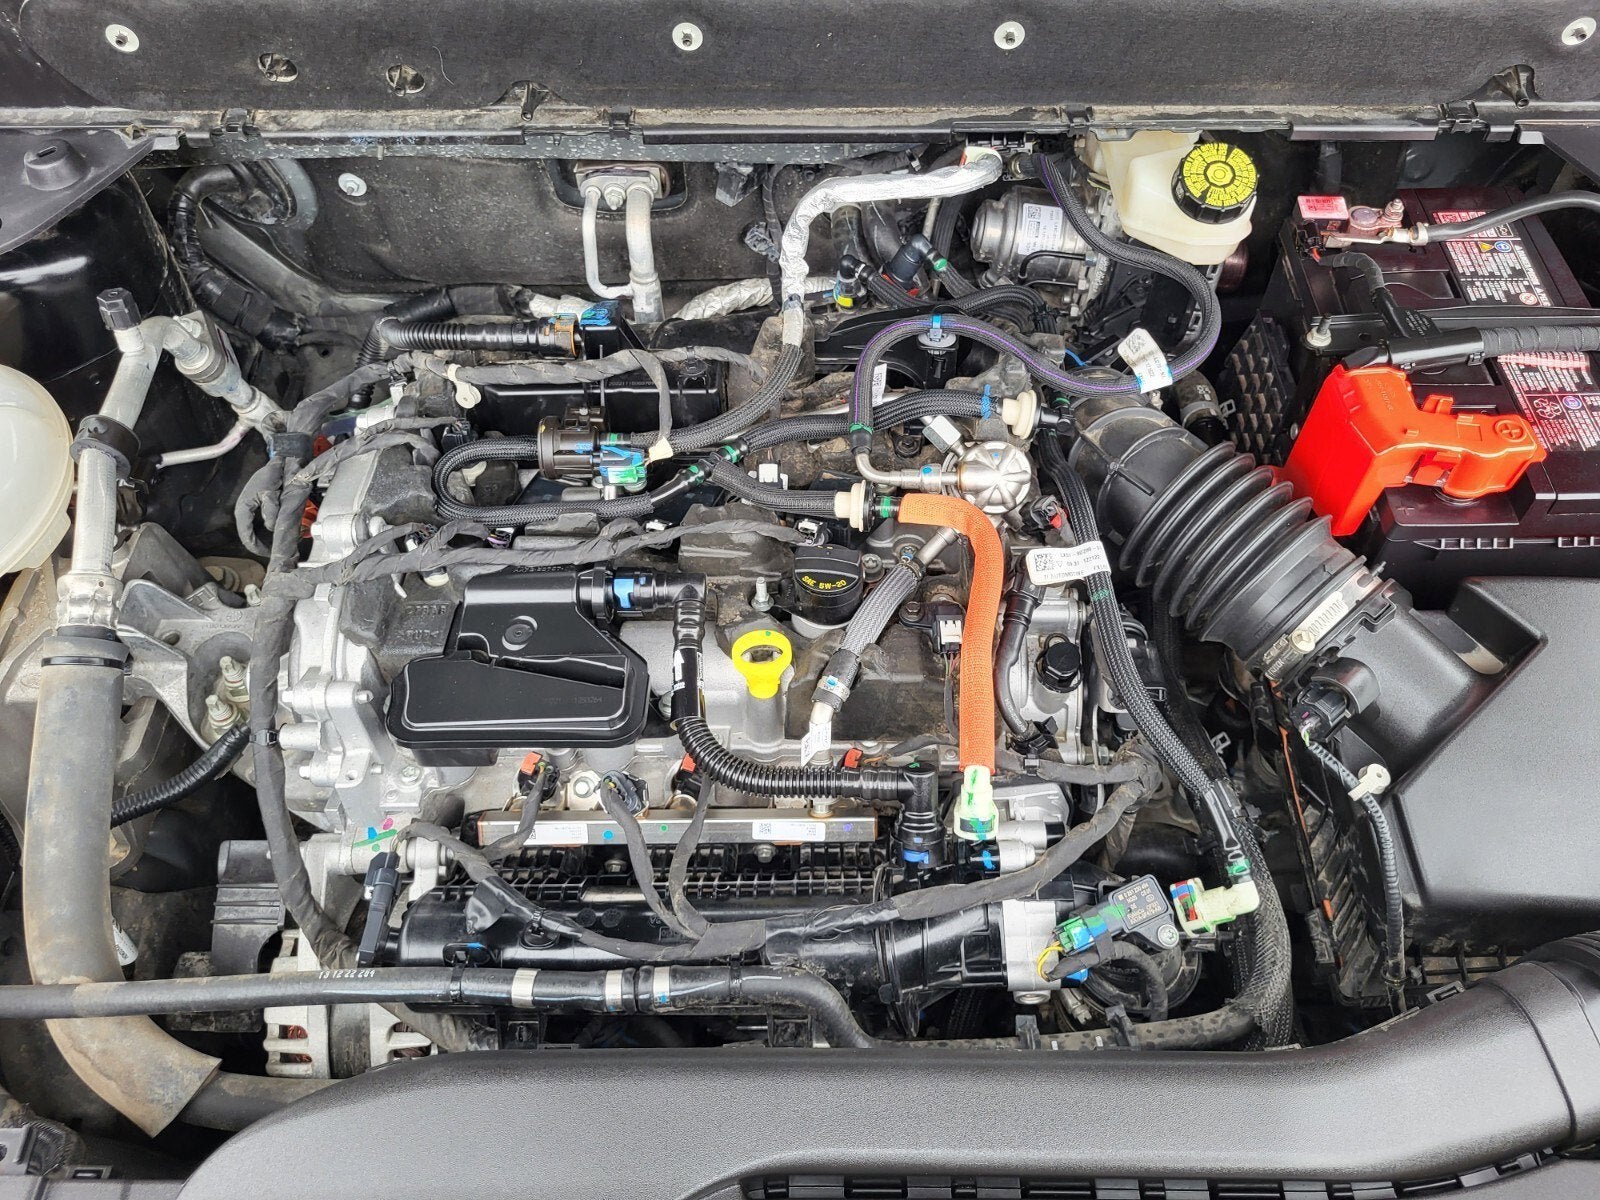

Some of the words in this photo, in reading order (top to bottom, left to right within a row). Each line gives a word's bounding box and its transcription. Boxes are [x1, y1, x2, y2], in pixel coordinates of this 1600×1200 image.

[801, 575, 816, 587] SAE
[818, 579, 847, 590] 5W-20
[332, 970, 344, 979] 12
[344, 969, 357, 978] 22
